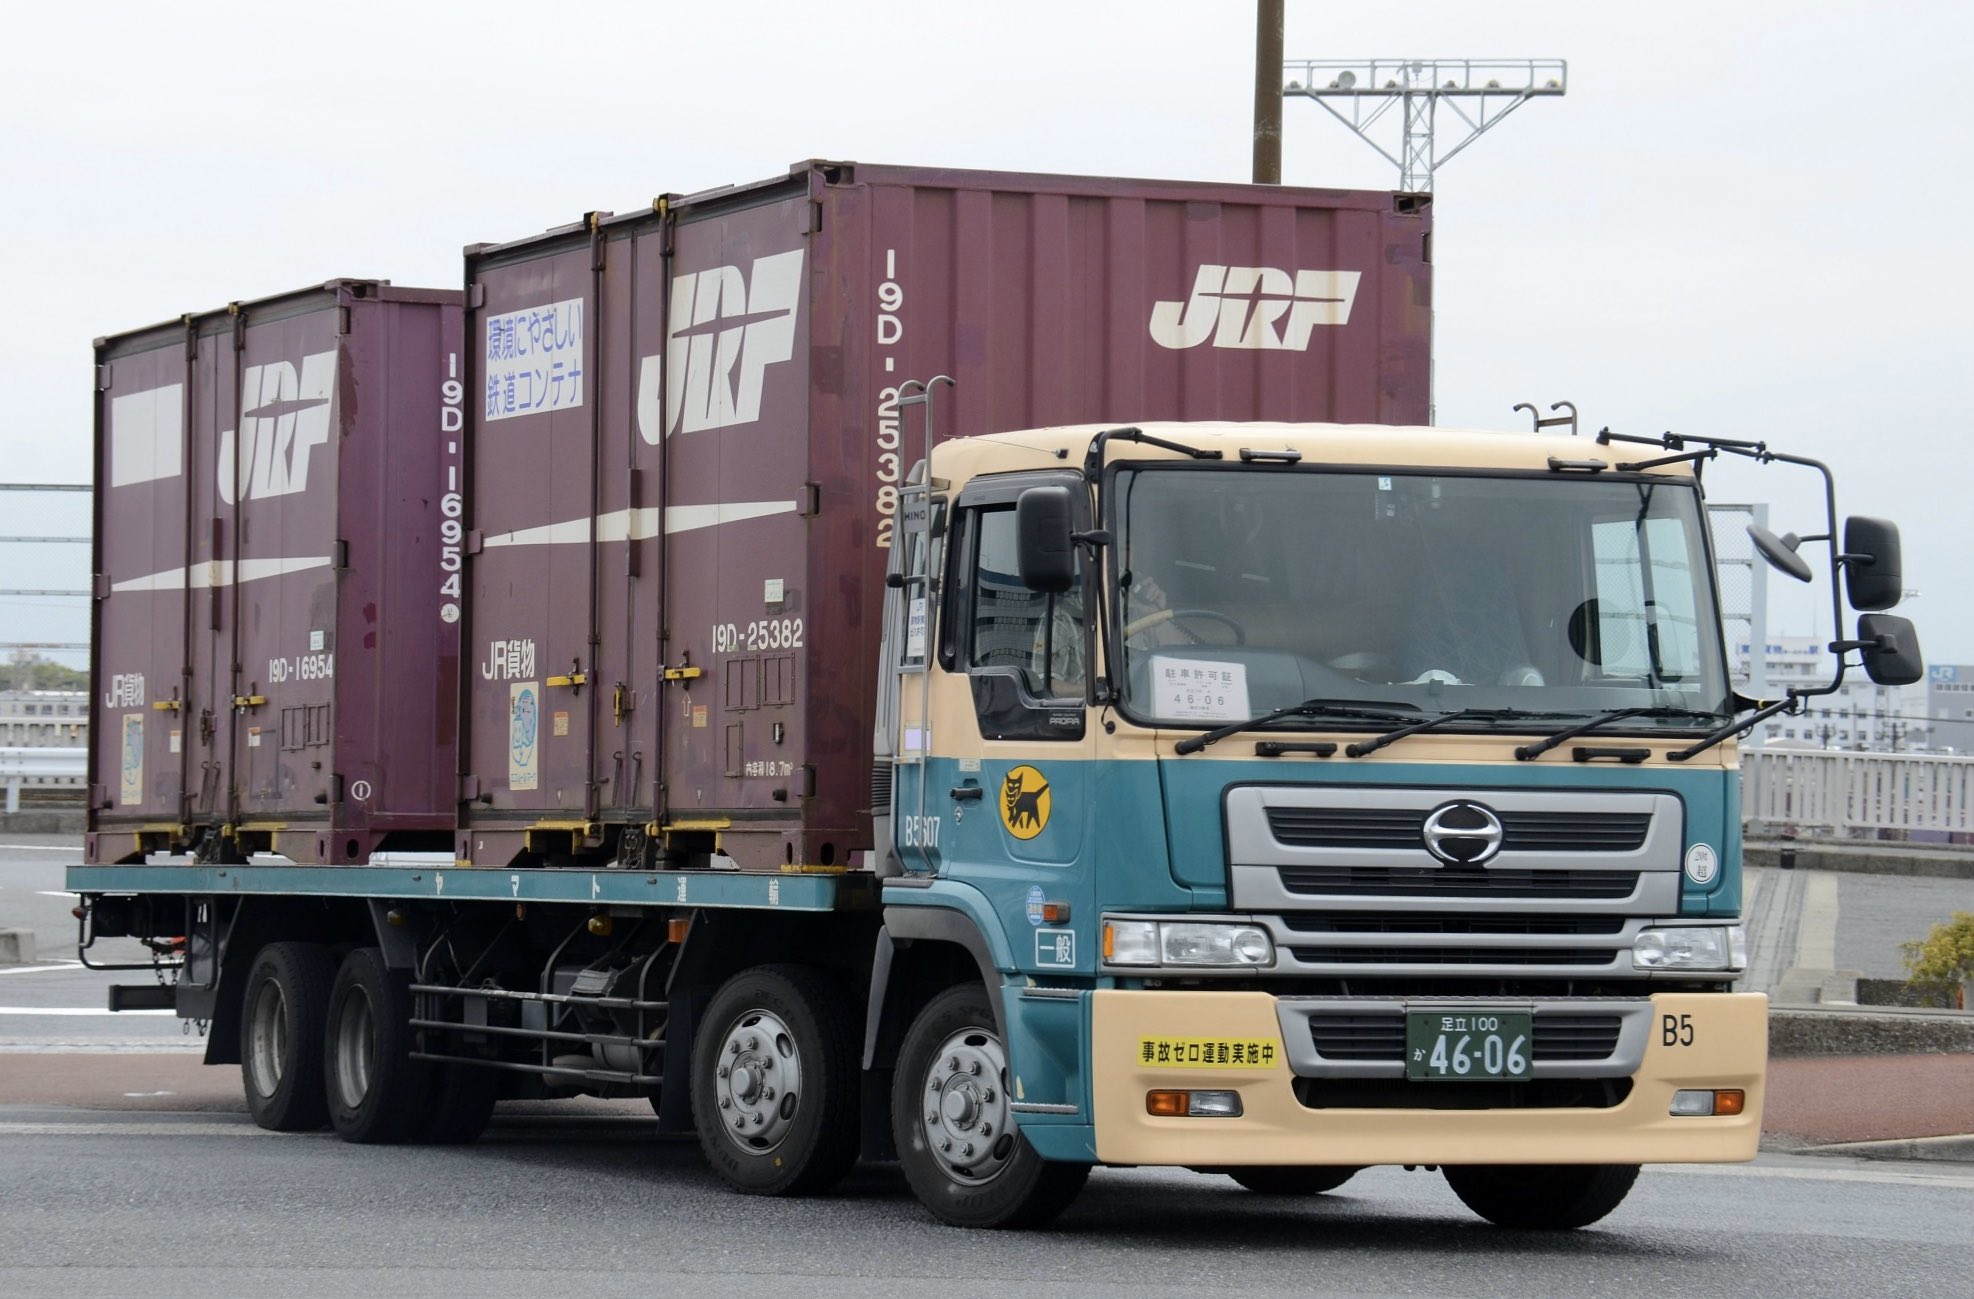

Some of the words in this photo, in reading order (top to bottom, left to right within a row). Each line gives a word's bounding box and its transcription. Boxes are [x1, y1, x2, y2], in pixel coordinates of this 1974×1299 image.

[1149, 264, 1362, 351] JRF
[488, 303, 582, 360] 環境にやさしい
[638, 248, 805, 446] JRF
[487, 358, 582, 416] 鉄道コンテナ
[904, 510, 926, 521] HINO
[712, 618, 803, 653] 19D-25382
[269, 654, 334, 683] 19D-16954
[482, 639, 535, 680] JR貨物
[105, 673, 145, 709] JR貨物
[1039, 934, 1072, 962] 一般
[1663, 1014, 1694, 1047] B5
[1142, 1040, 1274, 1065] 事故ゼロ運動実施中
[1429, 1034, 1526, 1075] 46-06
